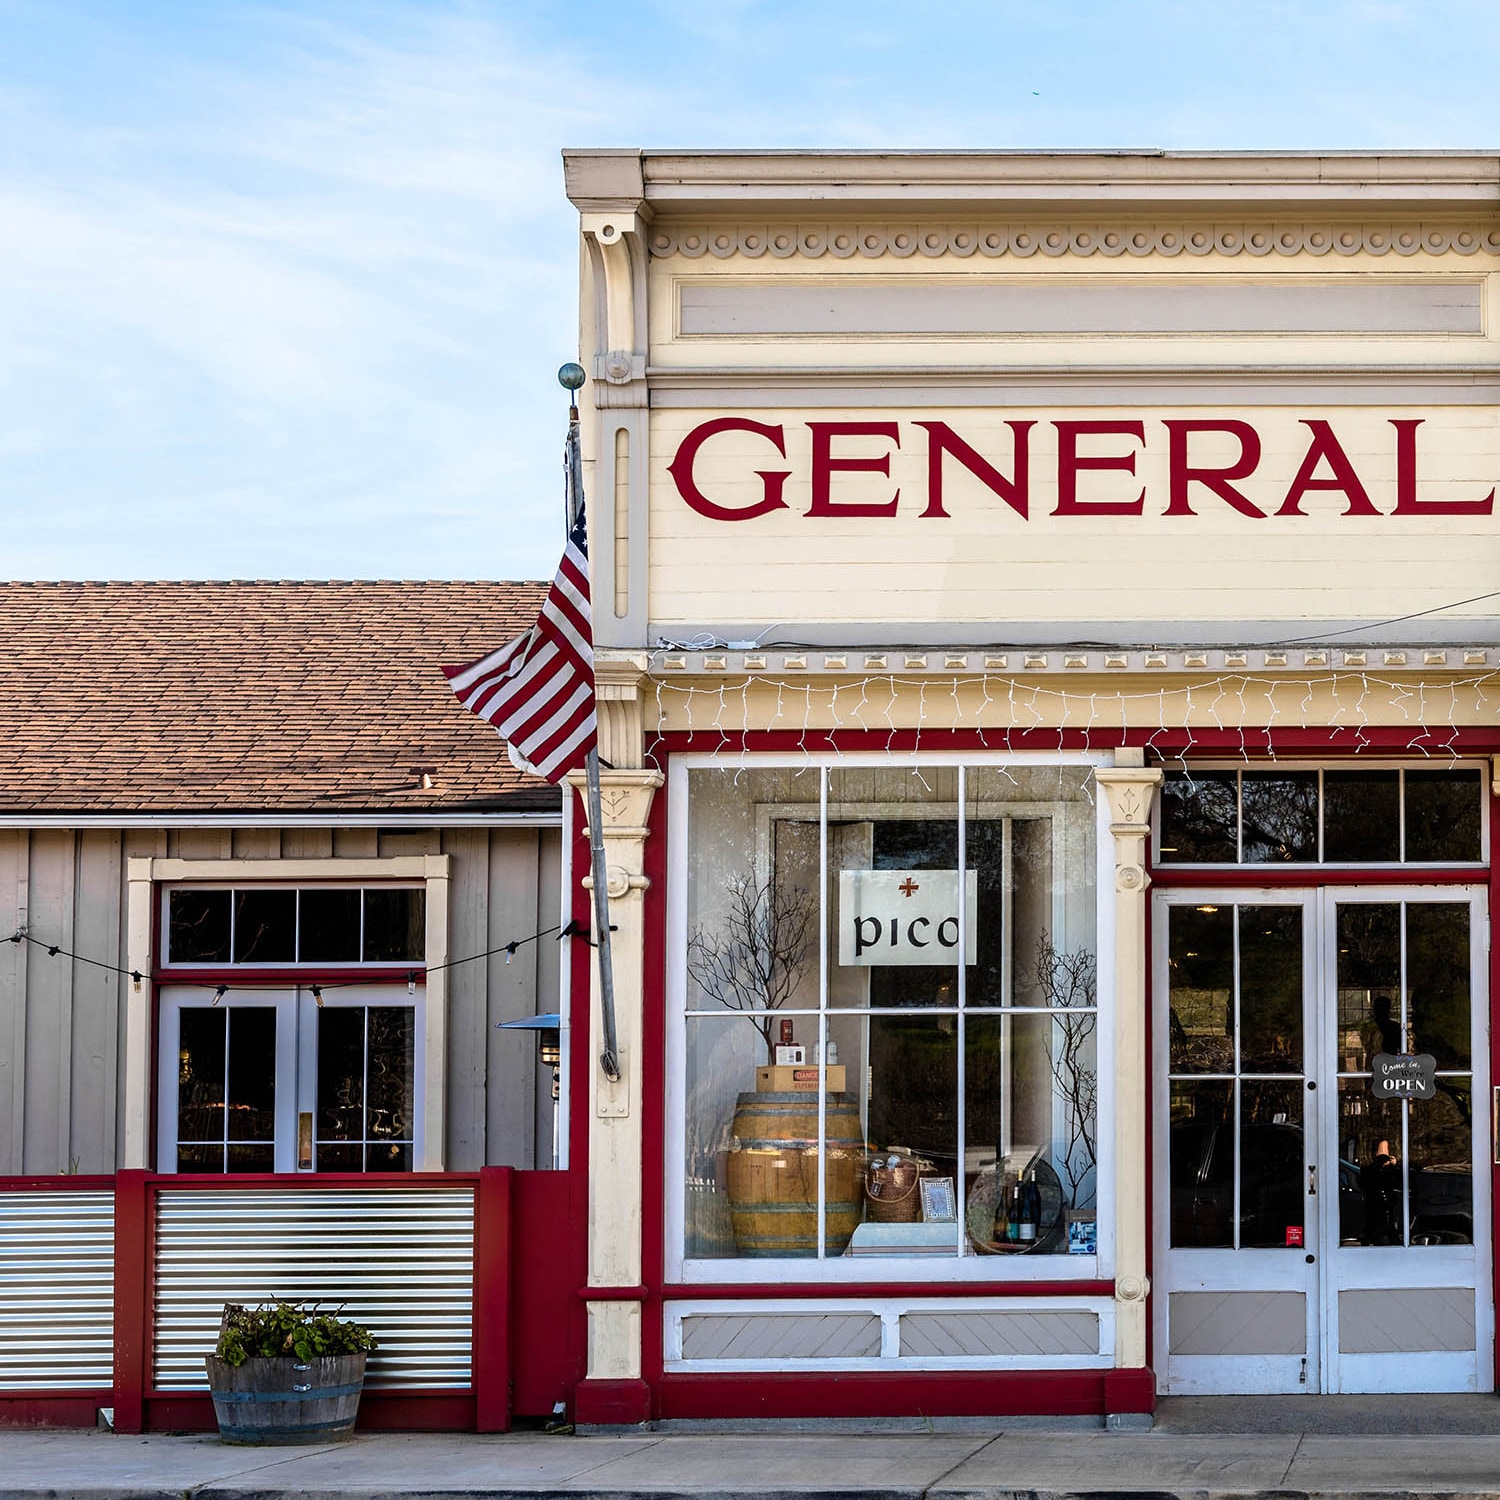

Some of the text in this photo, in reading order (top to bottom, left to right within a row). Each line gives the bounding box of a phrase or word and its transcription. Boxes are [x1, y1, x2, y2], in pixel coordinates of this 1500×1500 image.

[666, 416, 1496, 521] GENERAL
[853, 915, 959, 957] pico
[1382, 1062, 1406, 1075] Come
[1382, 1078, 1426, 1091] OPEN
